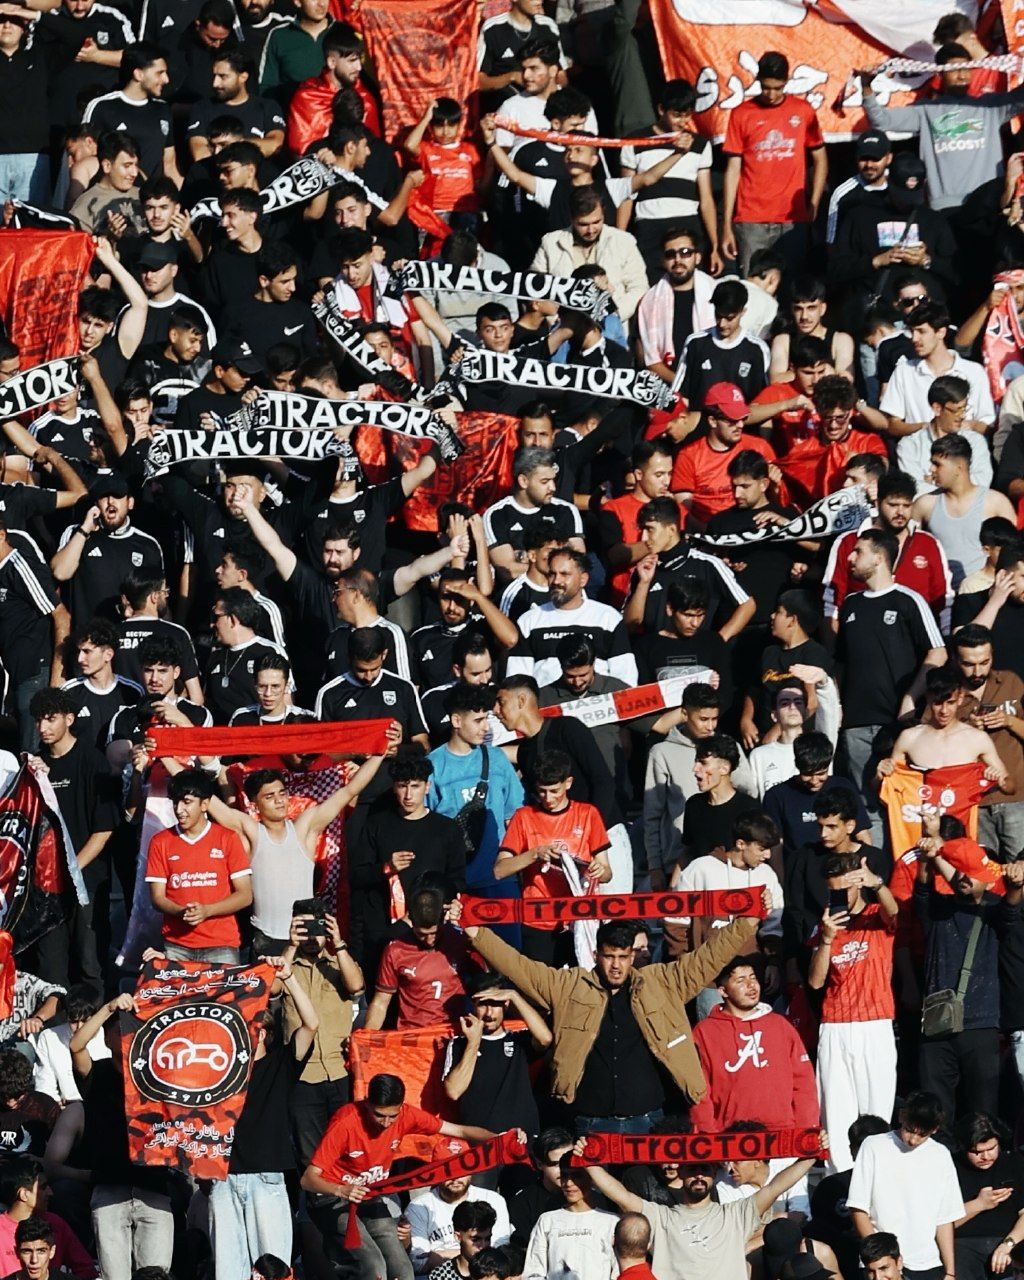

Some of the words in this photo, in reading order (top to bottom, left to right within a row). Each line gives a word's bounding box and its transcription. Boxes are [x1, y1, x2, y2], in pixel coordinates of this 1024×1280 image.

[479, 352, 634, 396] TRACTOR
[270, 393, 431, 437] TRACTOR
[150, 1006, 234, 1031] TRACTOR
